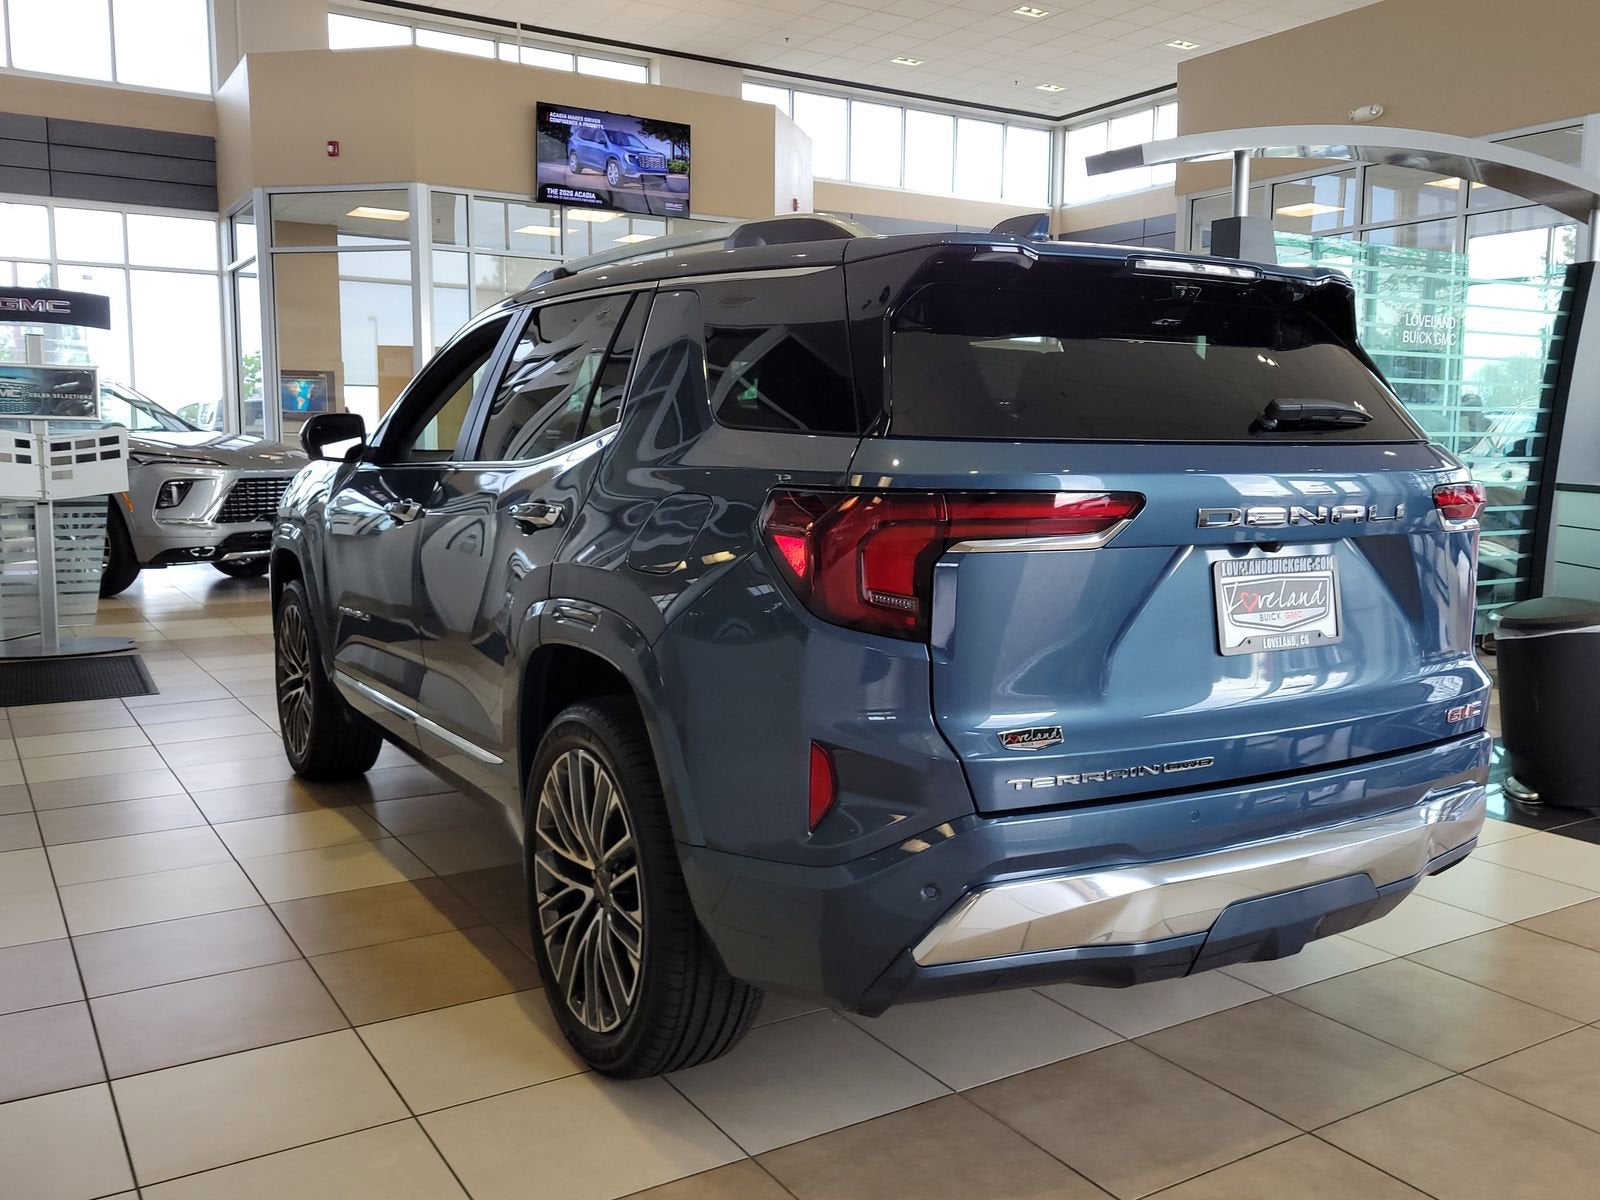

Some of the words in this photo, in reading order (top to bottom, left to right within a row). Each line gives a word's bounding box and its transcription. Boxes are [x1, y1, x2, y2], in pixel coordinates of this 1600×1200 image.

[546, 187, 559, 195] THE
[574, 190, 596, 200] ACADIA
[0, 297, 71, 314] GMC
[1405, 313, 1456, 330] LOVELAND
[1402, 330, 1432, 344] BUICK
[1434, 332, 1457, 346] GMC
[0, 388, 21, 398] MC
[52, 392, 94, 400] SELECTIONS
[1197, 503, 1406, 529] DENALI
[1221, 555, 1334, 577] LOVELANDBUICKGMC.COM
[1259, 613, 1281, 622] BUICK
[1285, 611, 1303, 620] GMC
[1262, 635, 1299, 649] LOVELAND,
[1300, 634, 1310, 646] CO
[1007, 764, 1160, 790] TERRAIN
